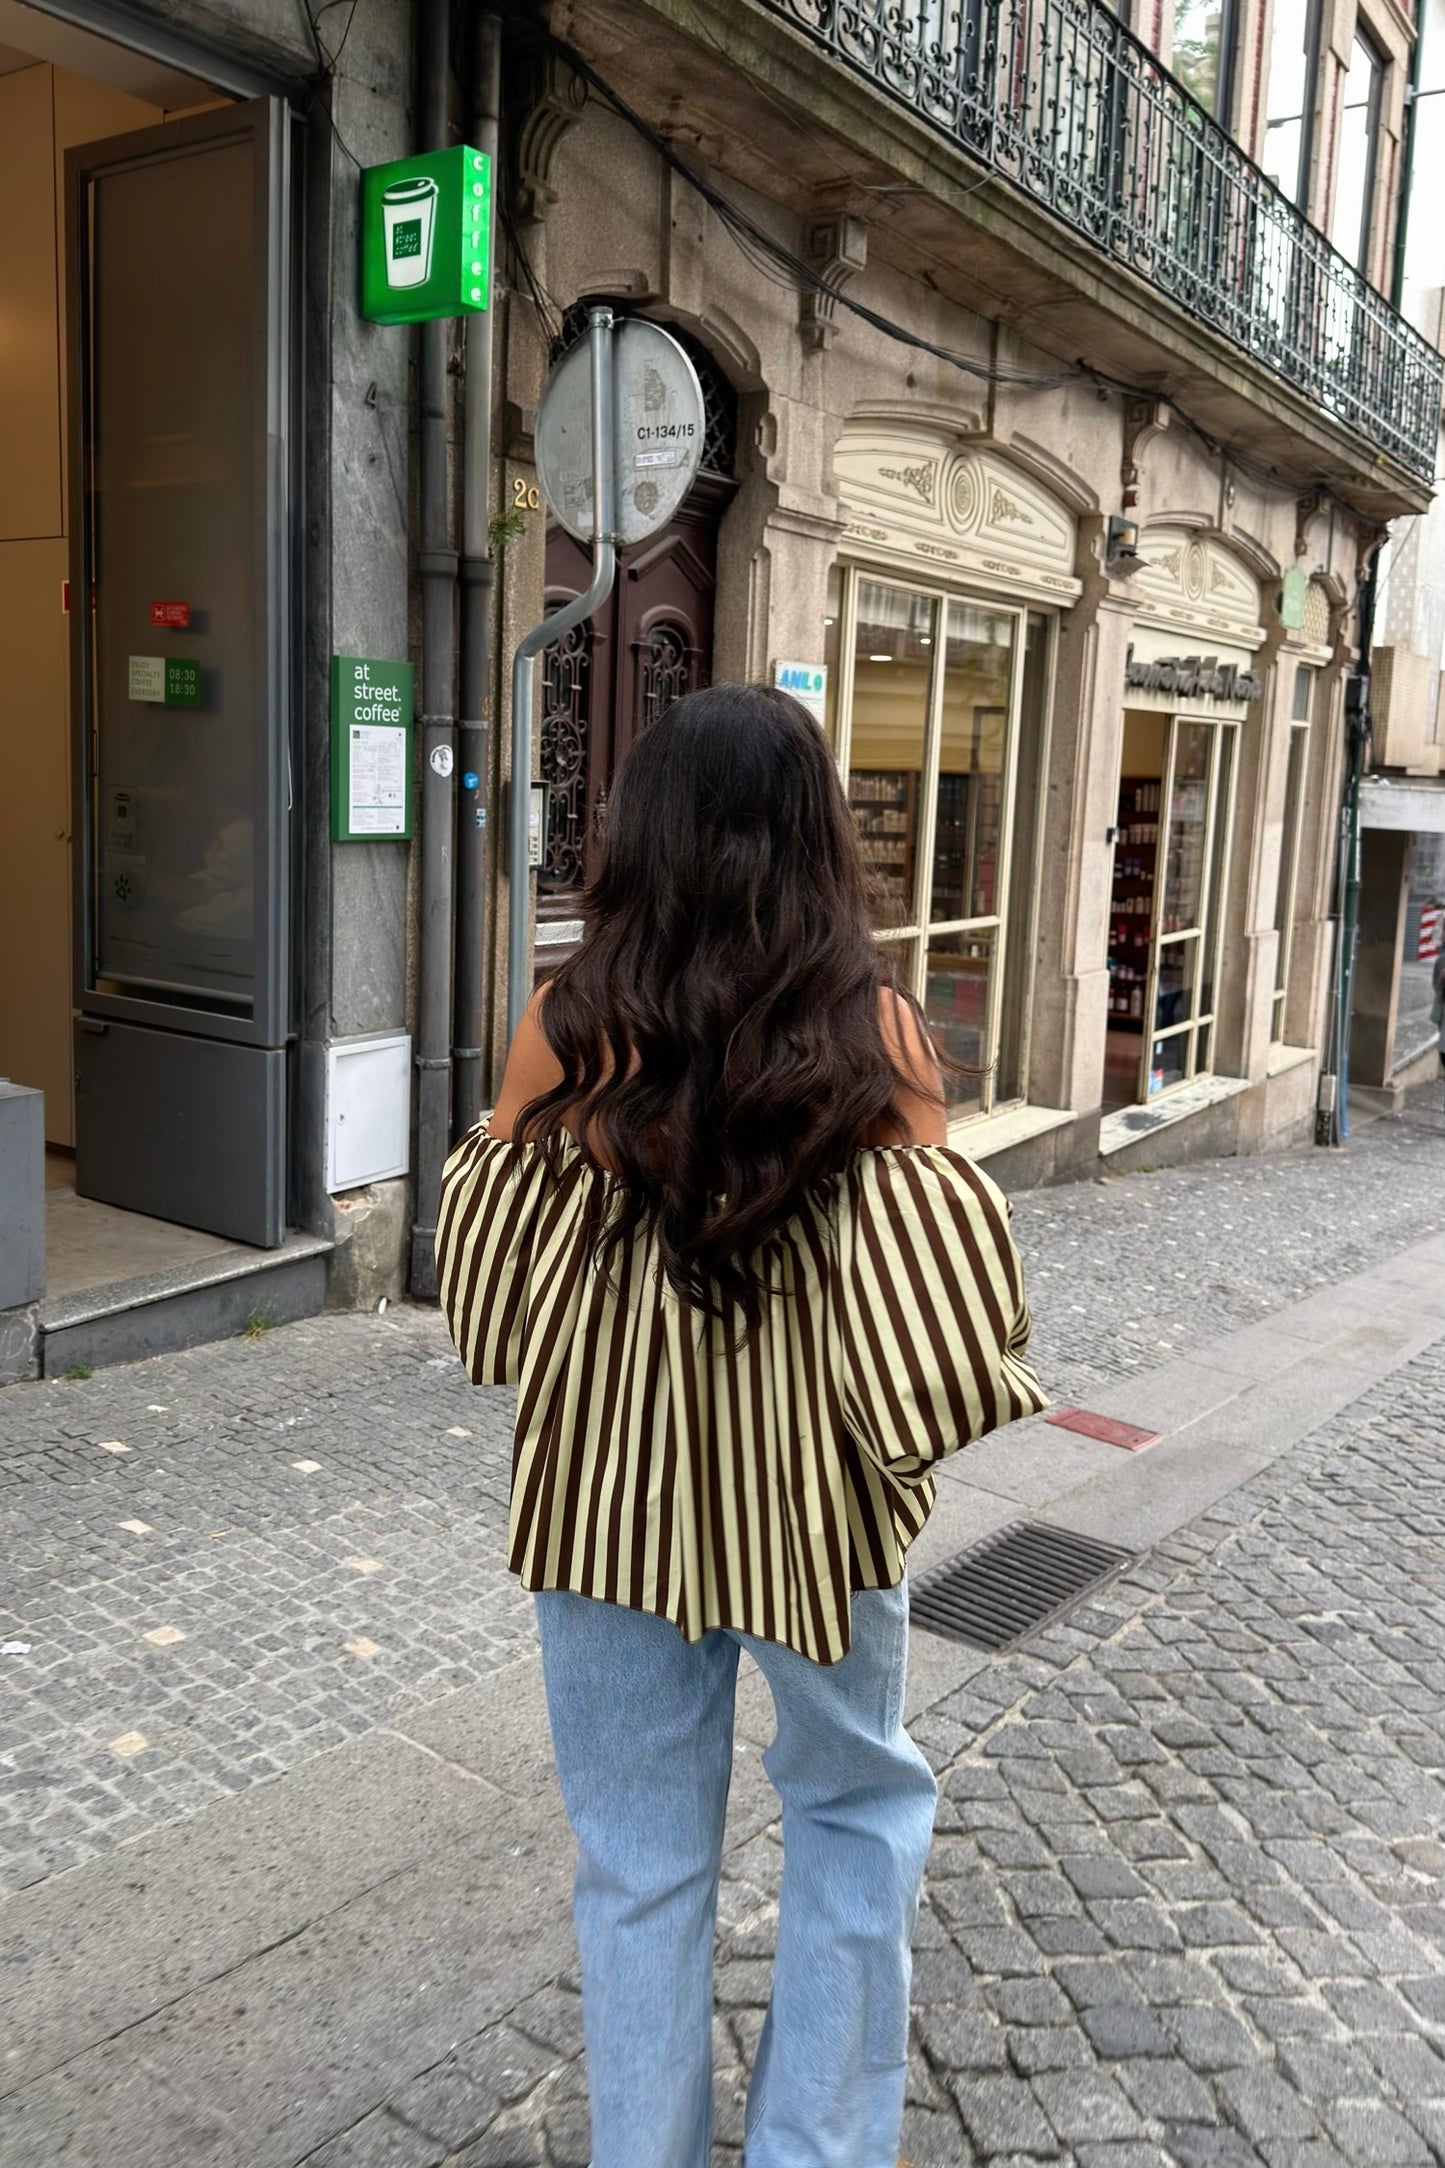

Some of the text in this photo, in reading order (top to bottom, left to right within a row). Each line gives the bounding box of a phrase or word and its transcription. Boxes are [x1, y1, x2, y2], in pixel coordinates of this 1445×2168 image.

[470, 155, 484, 302] coffee
[637, 423, 695, 440] C1-134/15
[169, 668, 196, 681] 08:30
[354, 663, 371, 680] at
[170, 683, 196, 696] 18:30
[354, 683, 402, 702] street.
